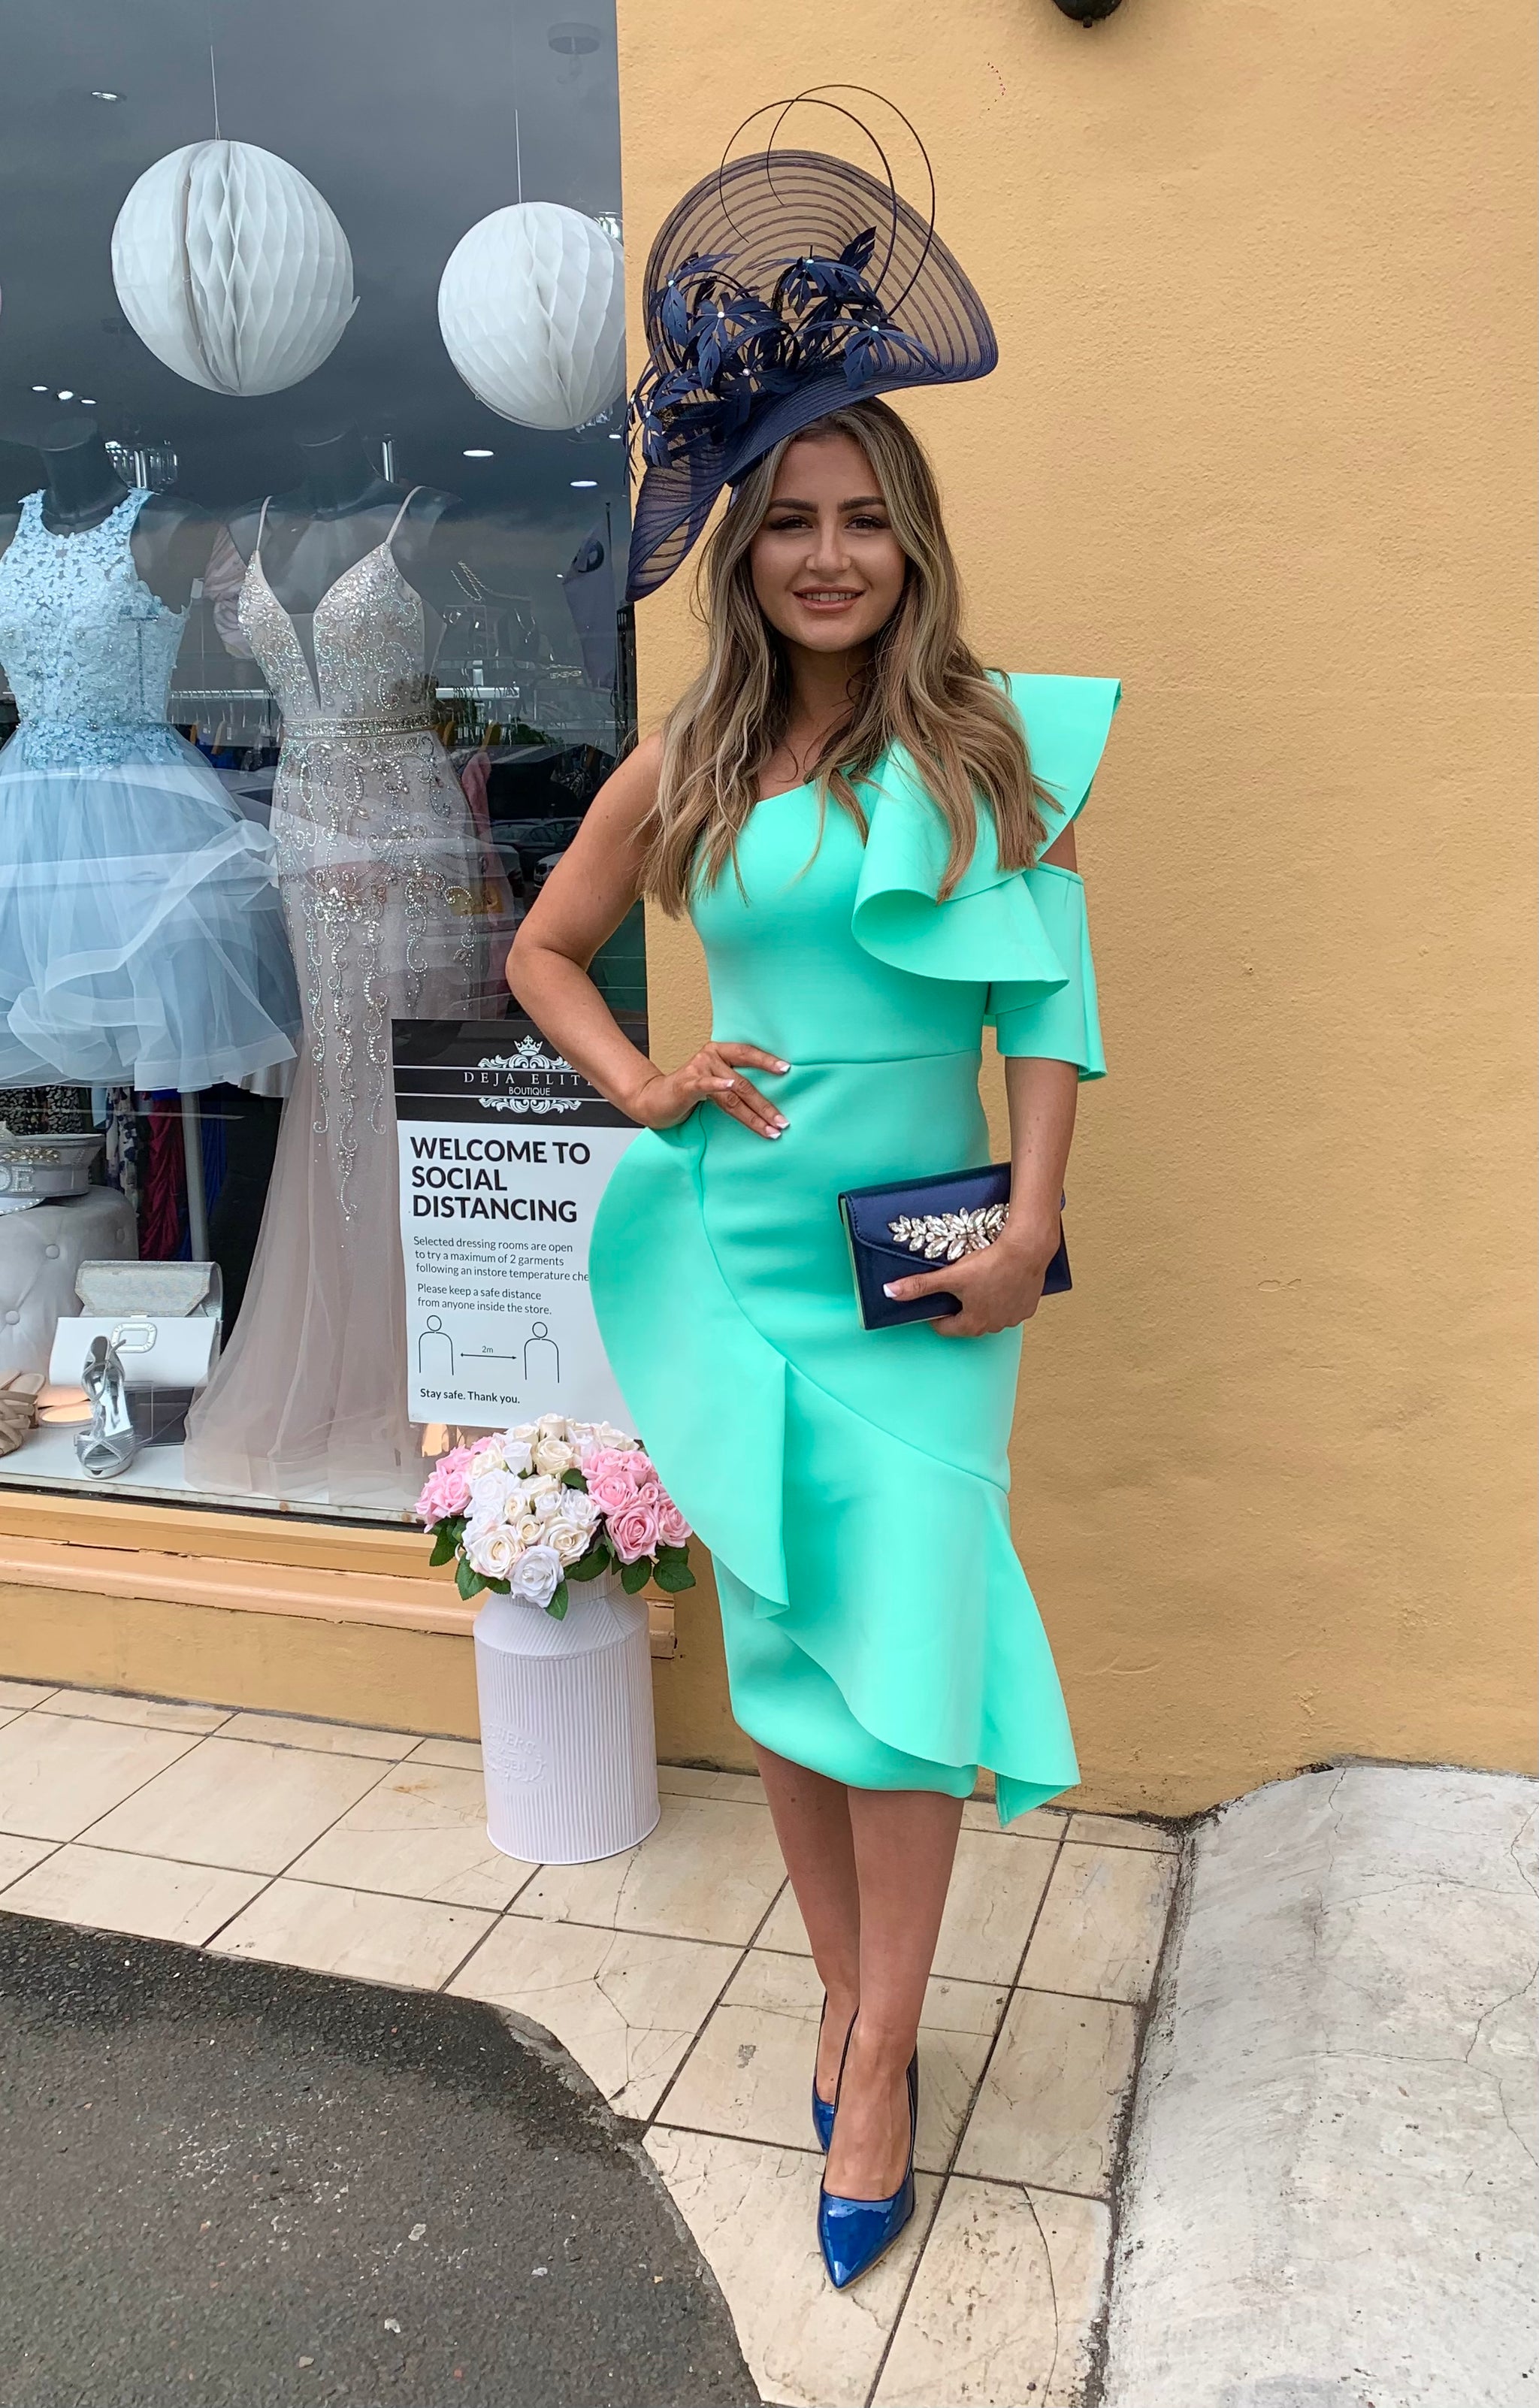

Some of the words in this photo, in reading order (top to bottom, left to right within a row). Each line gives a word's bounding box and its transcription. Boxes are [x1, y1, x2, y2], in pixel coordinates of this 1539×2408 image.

[464, 1072, 515, 1087] DEJA
[509, 1086, 551, 1096] BOUTIQUE
[410, 1136, 547, 1163] WELCOME
[552, 1142, 591, 1165] TO
[411, 1166, 508, 1191] SOCIAL
[413, 1194, 577, 1223] DISTANCING
[413, 1236, 454, 1247] Selected
[456, 1238, 496, 1251] dressing
[498, 1242, 529, 1250] rooms
[531, 1243, 547, 1251] are
[549, 1244, 573, 1254] open
[415, 1250, 425, 1259] to
[427, 1251, 441, 1261] try
[450, 1252, 496, 1263] maximum
[497, 1254, 508, 1263] of
[509, 1254, 516, 1264] 2
[518, 1257, 564, 1266] garments
[416, 1263, 459, 1277] following
[461, 1267, 472, 1275] an
[474, 1266, 507, 1278] instore
[509, 1269, 570, 1281] temperature
[417, 1283, 447, 1294] Please
[449, 1284, 471, 1297] keep
[480, 1287, 500, 1297] safe
[502, 1288, 542, 1300] distance
[418, 1296, 440, 1308] from
[442, 1301, 475, 1310] anyone
[477, 1301, 505, 1311] inside
[507, 1302, 523, 1313] the
[525, 1305, 552, 1314] store.
[482, 1345, 494, 1354] 2m
[420, 1388, 442, 1400] Stay
[443, 1390, 466, 1400] safe.
[467, 1390, 497, 1402] Thank
[500, 1396, 521, 1404] you.
